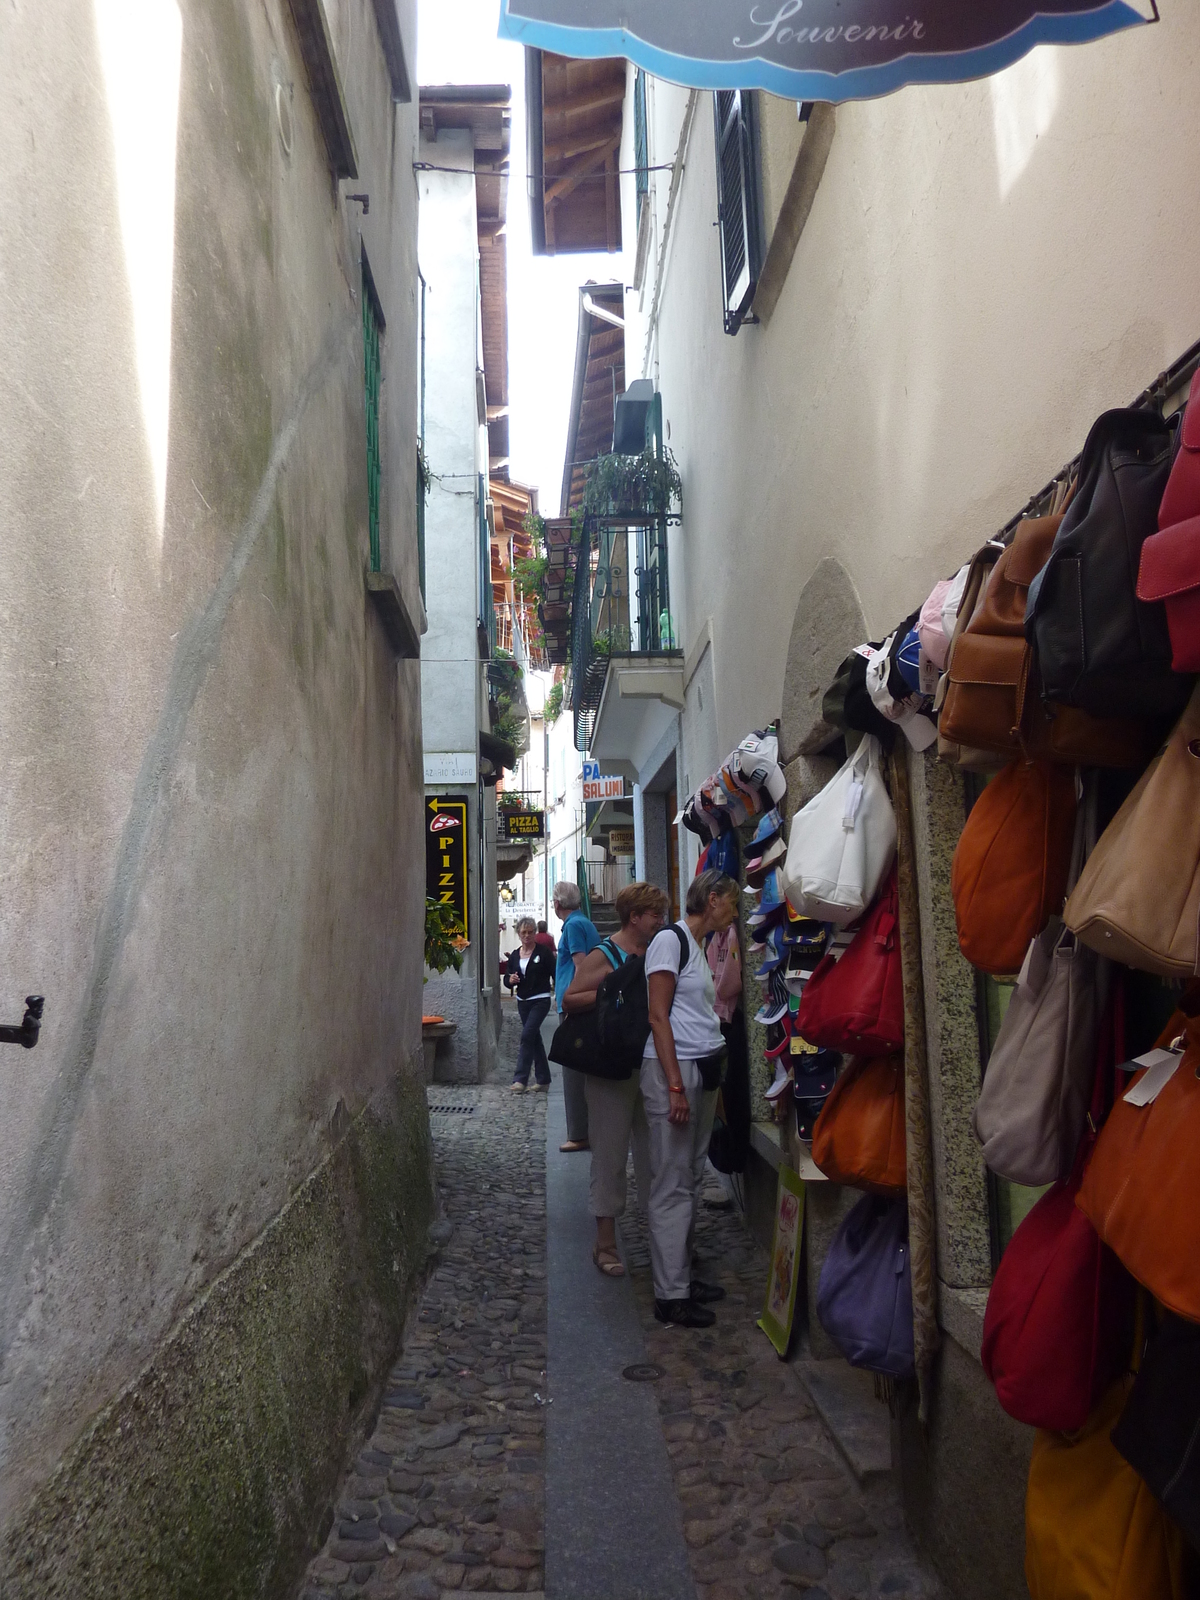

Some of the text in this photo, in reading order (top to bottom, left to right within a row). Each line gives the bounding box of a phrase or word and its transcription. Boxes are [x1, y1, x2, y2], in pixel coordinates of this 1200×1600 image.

[733, 0, 926, 48] Souvenir
[583, 763, 618, 782] PA
[583, 780, 623, 800] SALUMI
[509, 816, 539, 827] PIZZA
[438, 837, 456, 904] PIZZ
